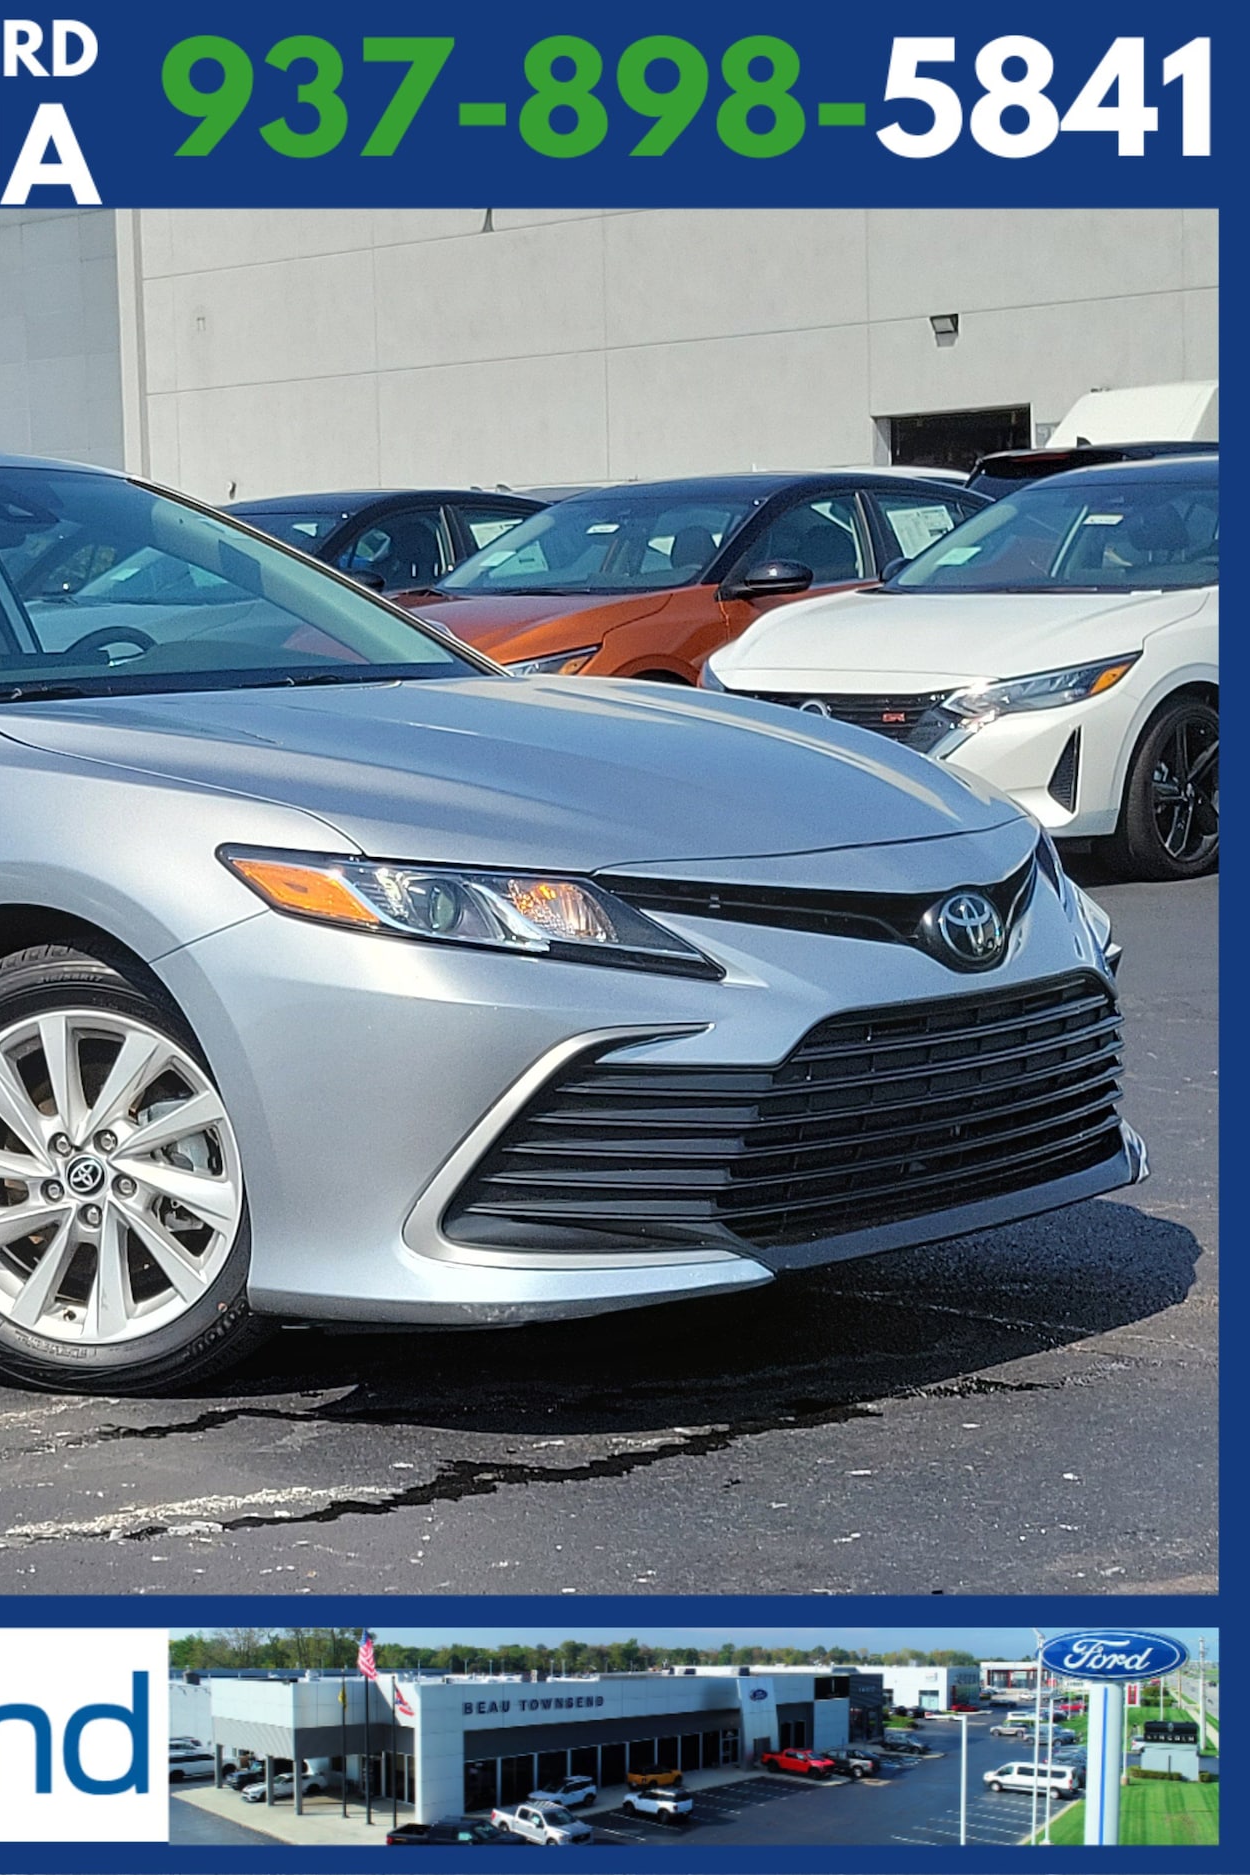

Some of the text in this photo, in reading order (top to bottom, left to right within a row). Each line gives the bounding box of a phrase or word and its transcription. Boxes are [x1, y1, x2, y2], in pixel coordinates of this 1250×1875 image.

[1063, 1639, 1154, 1670] Ford
[462, 1695, 605, 1716] BEAU TOWNSEND
